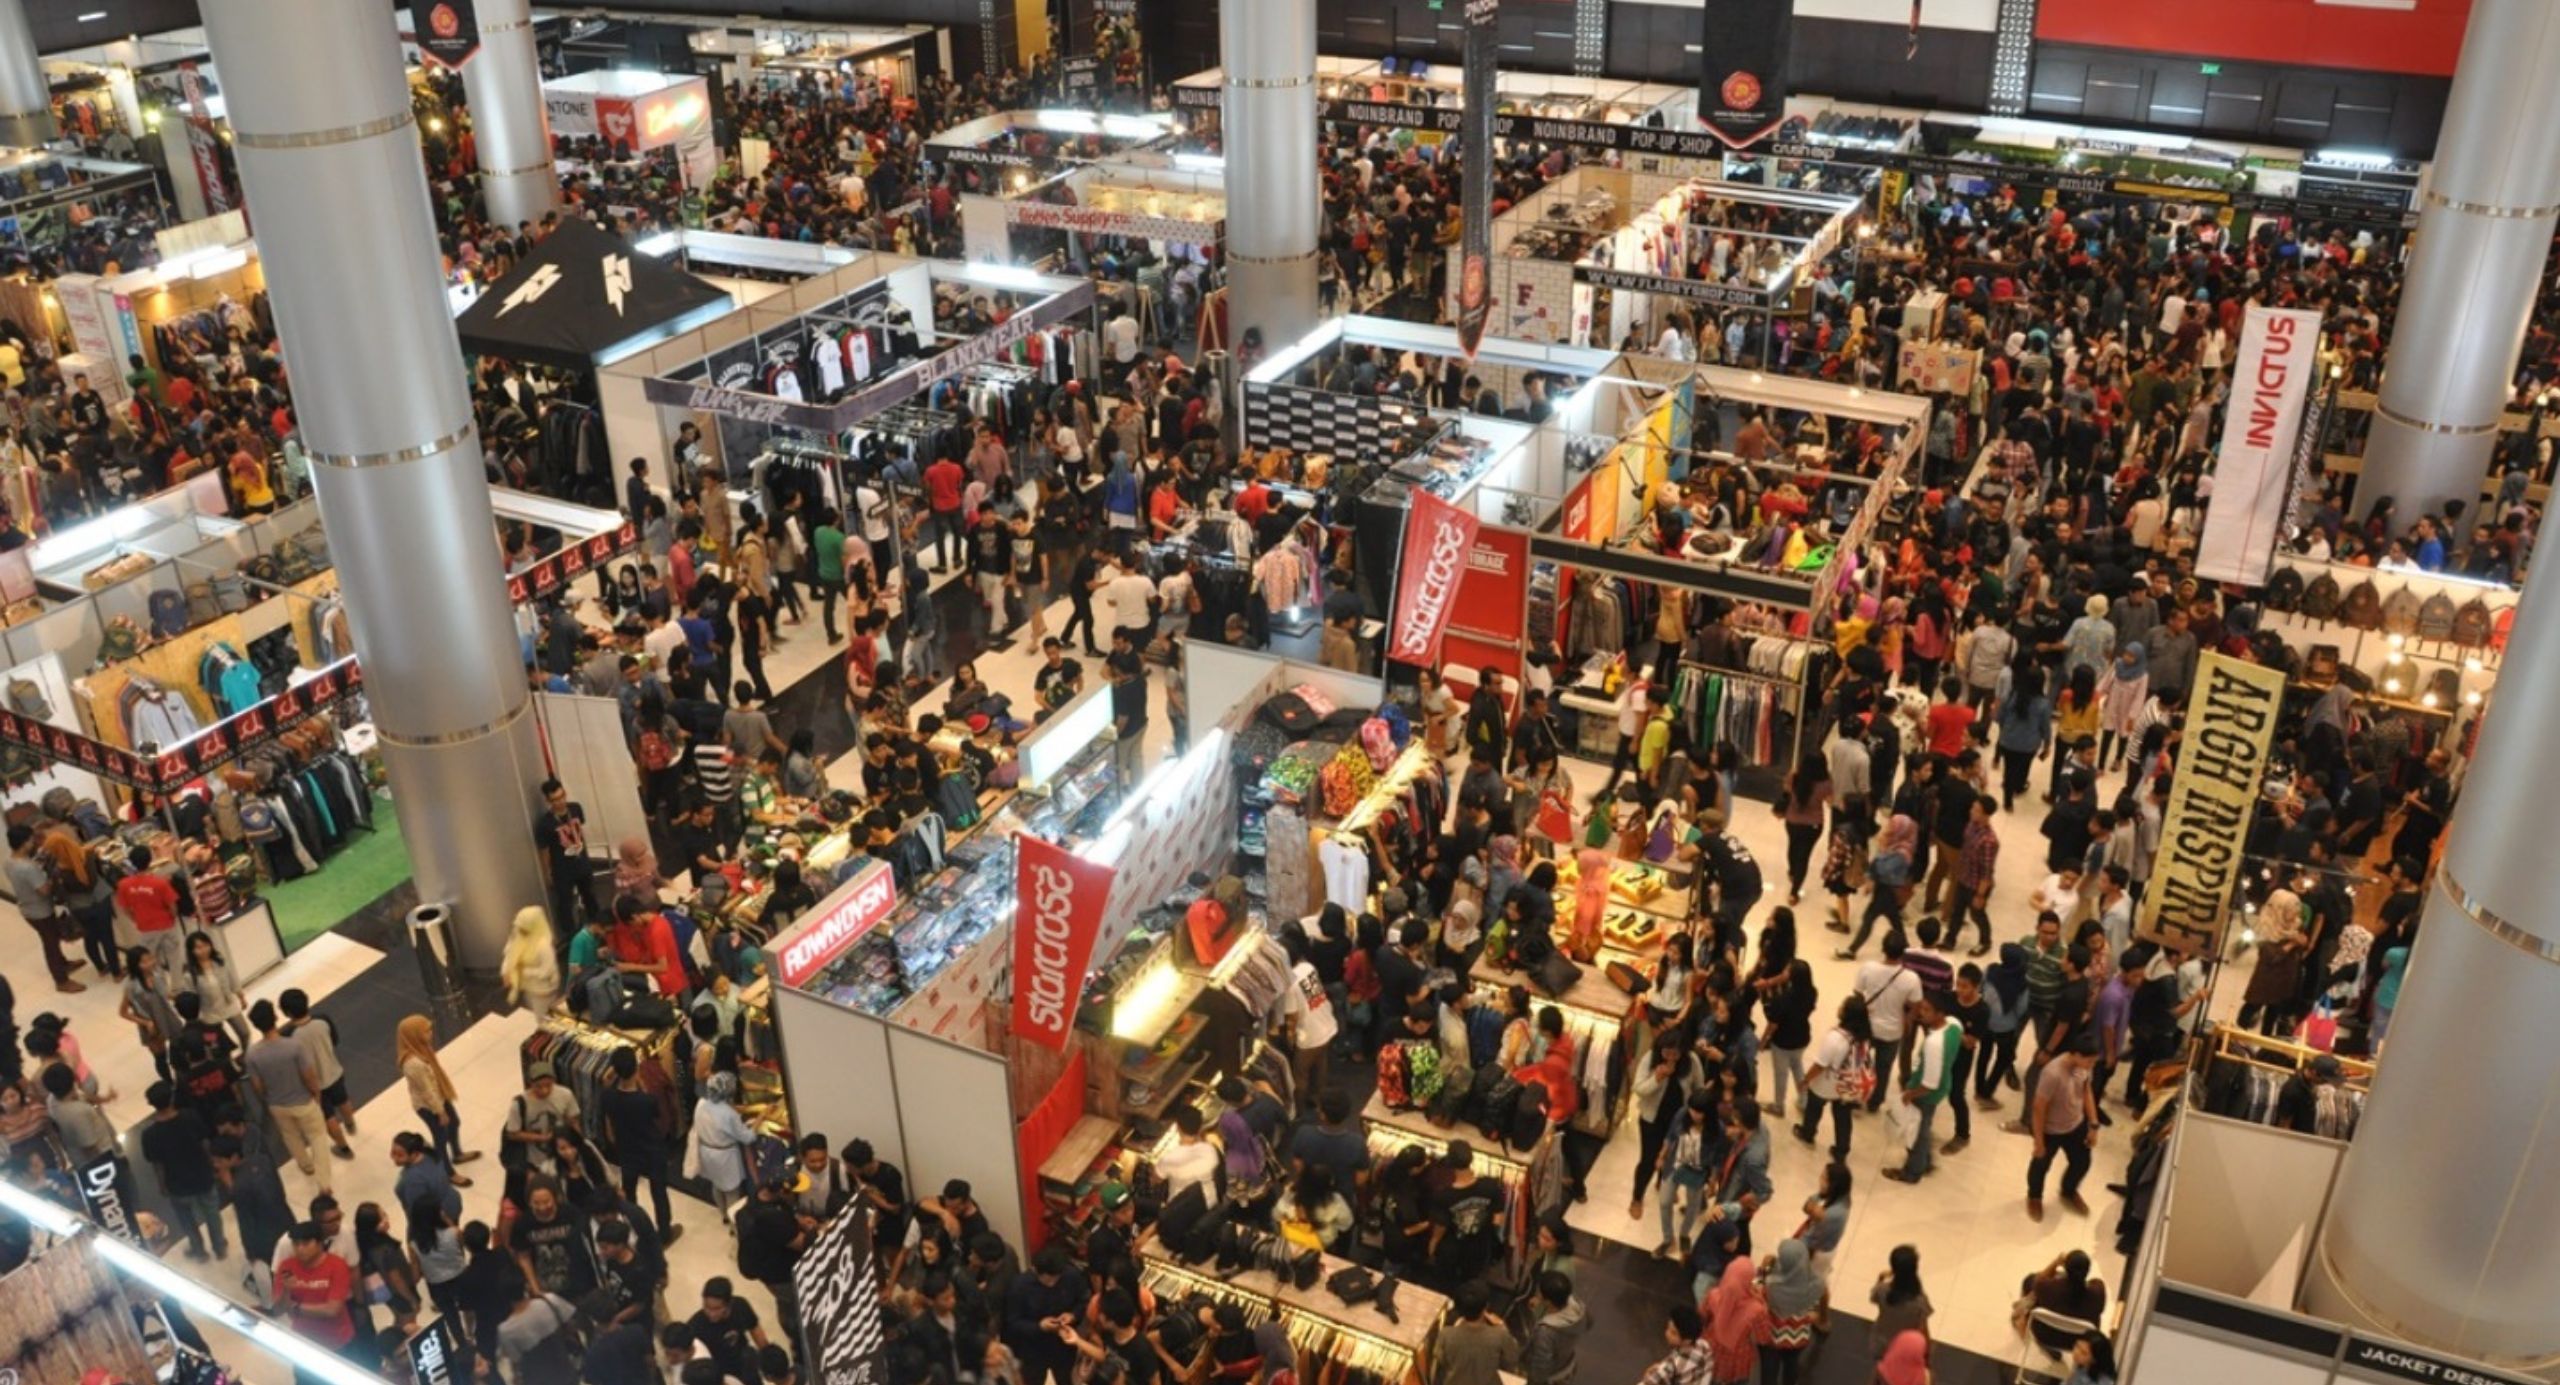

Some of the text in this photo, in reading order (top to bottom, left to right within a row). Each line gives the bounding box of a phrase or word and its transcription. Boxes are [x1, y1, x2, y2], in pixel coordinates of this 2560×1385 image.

[1347, 103, 1424, 126] NOINBRAND
[1533, 121, 1617, 144] NOINBRAND
[1631, 129, 1677, 150] POP-UP
[1679, 134, 1713, 153] SHOP
[1063, 207, 1109, 230] Supply
[916, 314, 1035, 387] BLANKWEAR
[2246, 317, 2296, 448] INVICTUS
[2192, 665, 2272, 793] ARGH
[2153, 788, 2245, 952] INSPIRE
[86, 1161, 138, 1244] Dynam
[2360, 1347, 2441, 1377] JACKET
